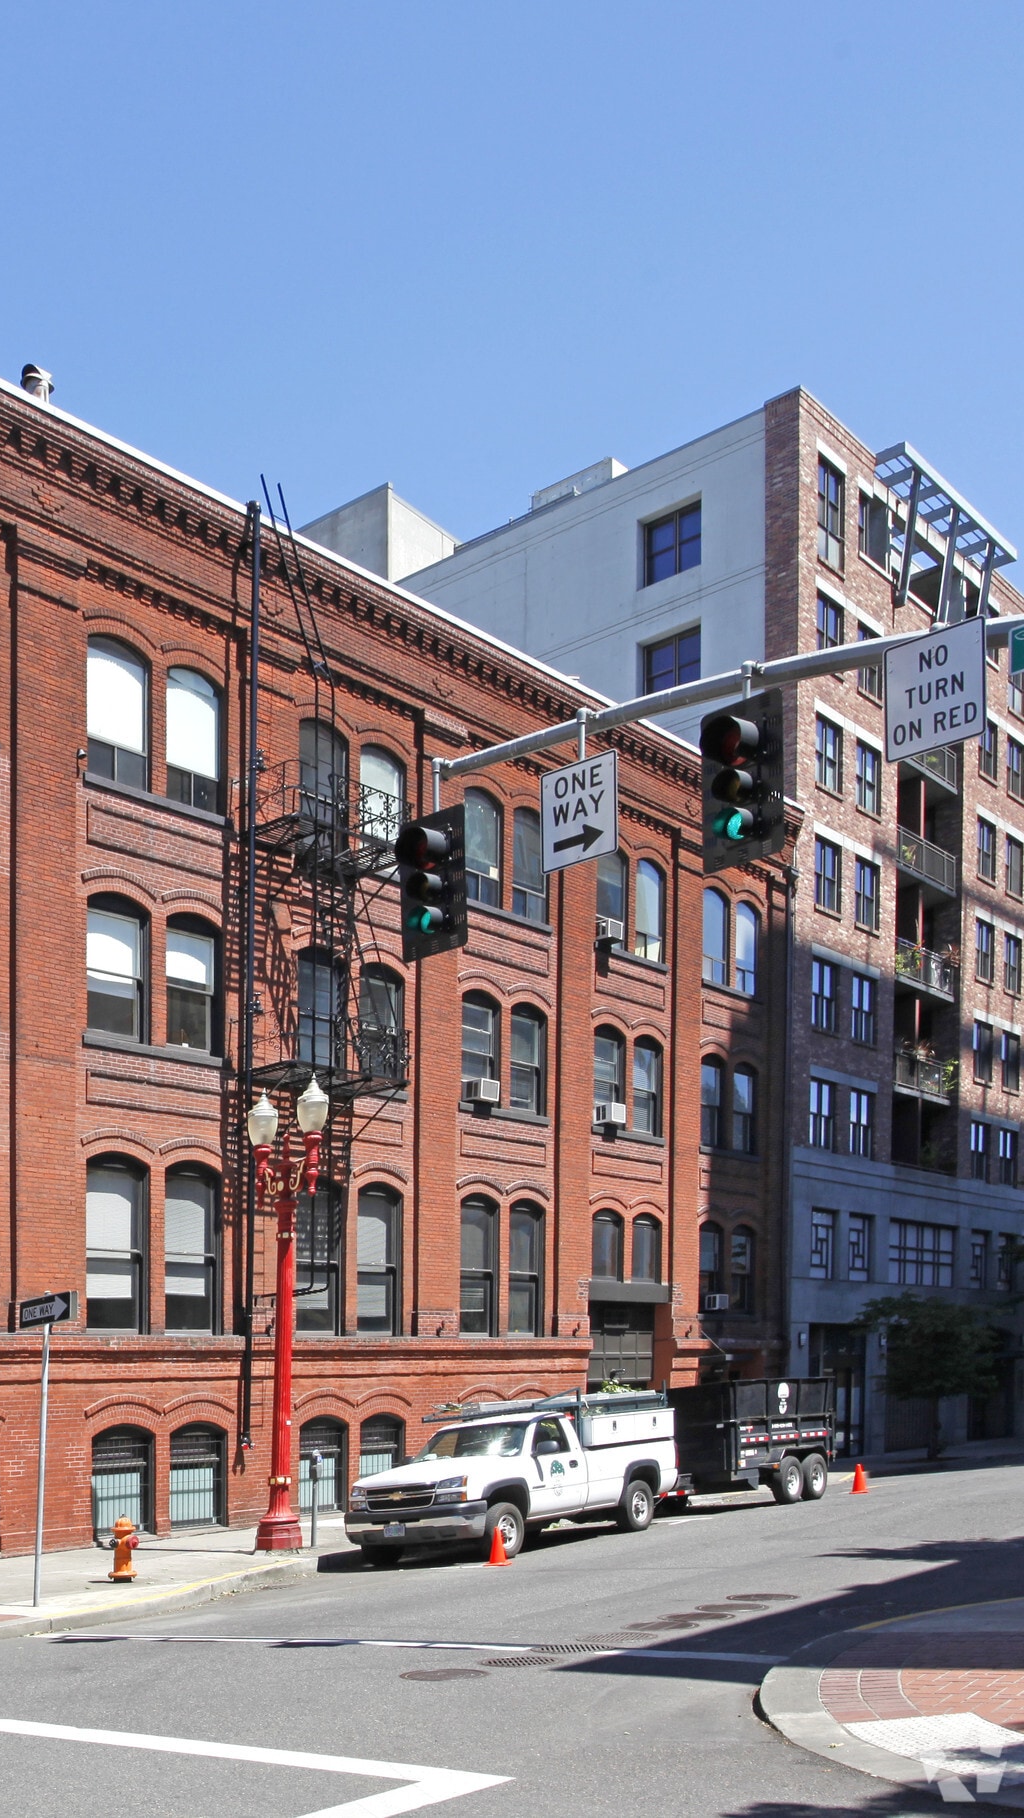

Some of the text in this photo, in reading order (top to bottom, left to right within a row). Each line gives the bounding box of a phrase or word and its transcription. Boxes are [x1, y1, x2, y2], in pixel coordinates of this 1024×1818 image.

[918, 644, 948, 673] NO
[904, 671, 964, 709] TURN
[893, 701, 977, 746] ON RED
[554, 763, 603, 798] ONE
[552, 789, 605, 827] WAY
[24, 1304, 54, 1319] ONE WAY
